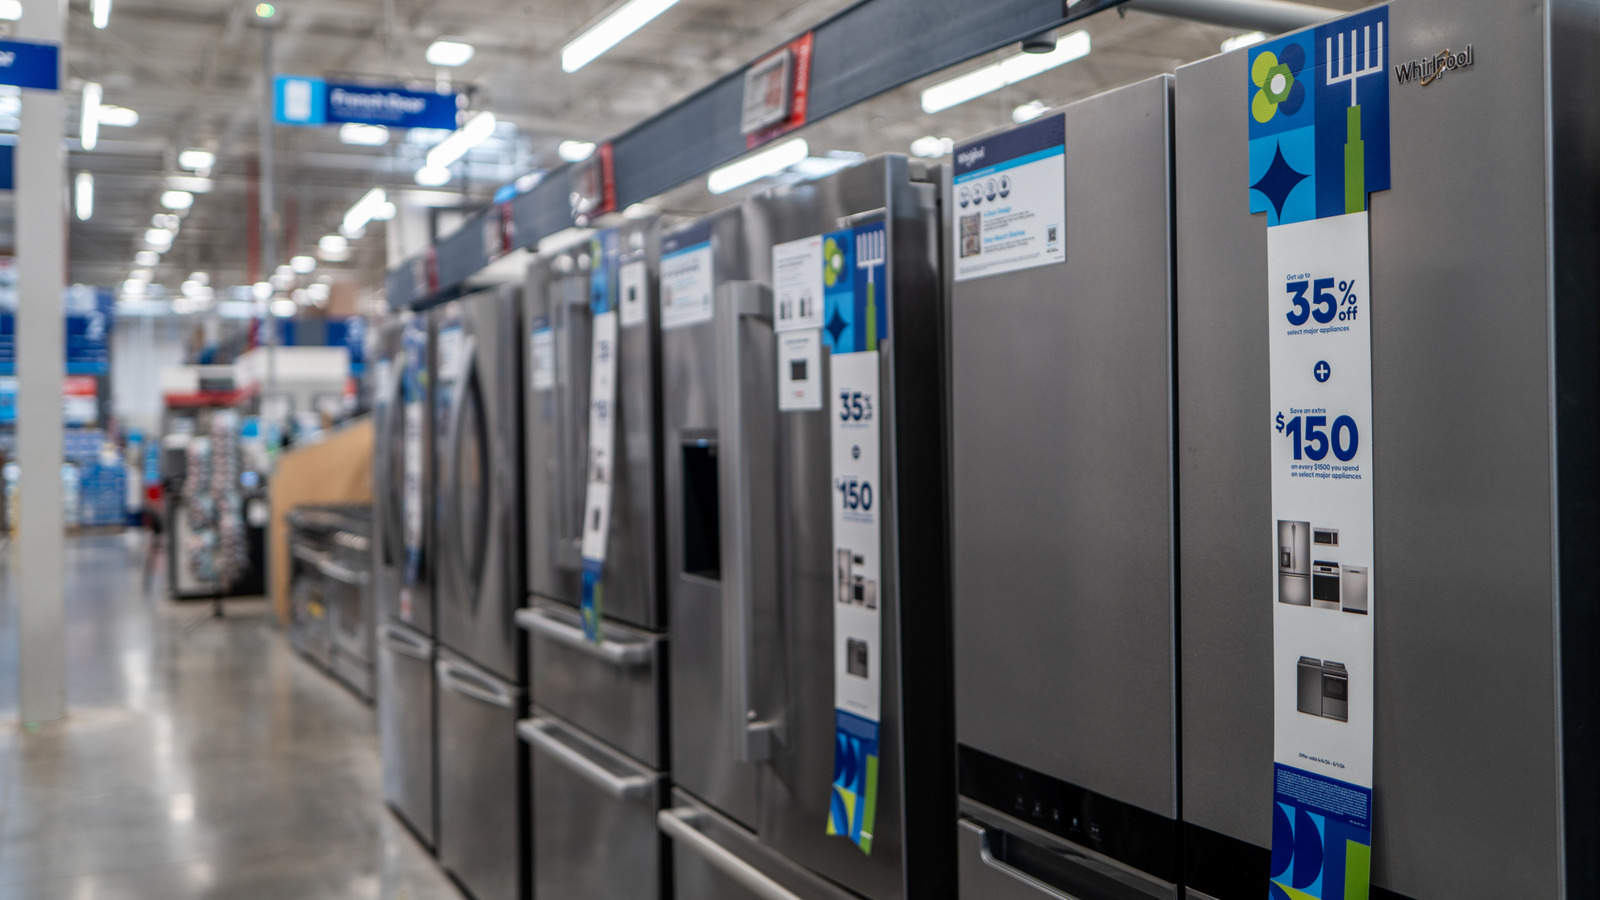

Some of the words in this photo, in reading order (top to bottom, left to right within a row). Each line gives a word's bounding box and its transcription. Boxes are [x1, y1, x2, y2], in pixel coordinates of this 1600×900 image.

[1394, 43, 1474, 86] Whirlpool
[1338, 305, 1358, 321] off
[1287, 328, 1302, 336] select
[1303, 327, 1318, 335] major
[1319, 326, 1349, 334] appliances
[1275, 411, 1359, 462] $150
[1298, 464, 1313, 472] every
[1314, 463, 1330, 471] $1500
[1298, 470, 1314, 478] select
[1315, 471, 1331, 480] major
